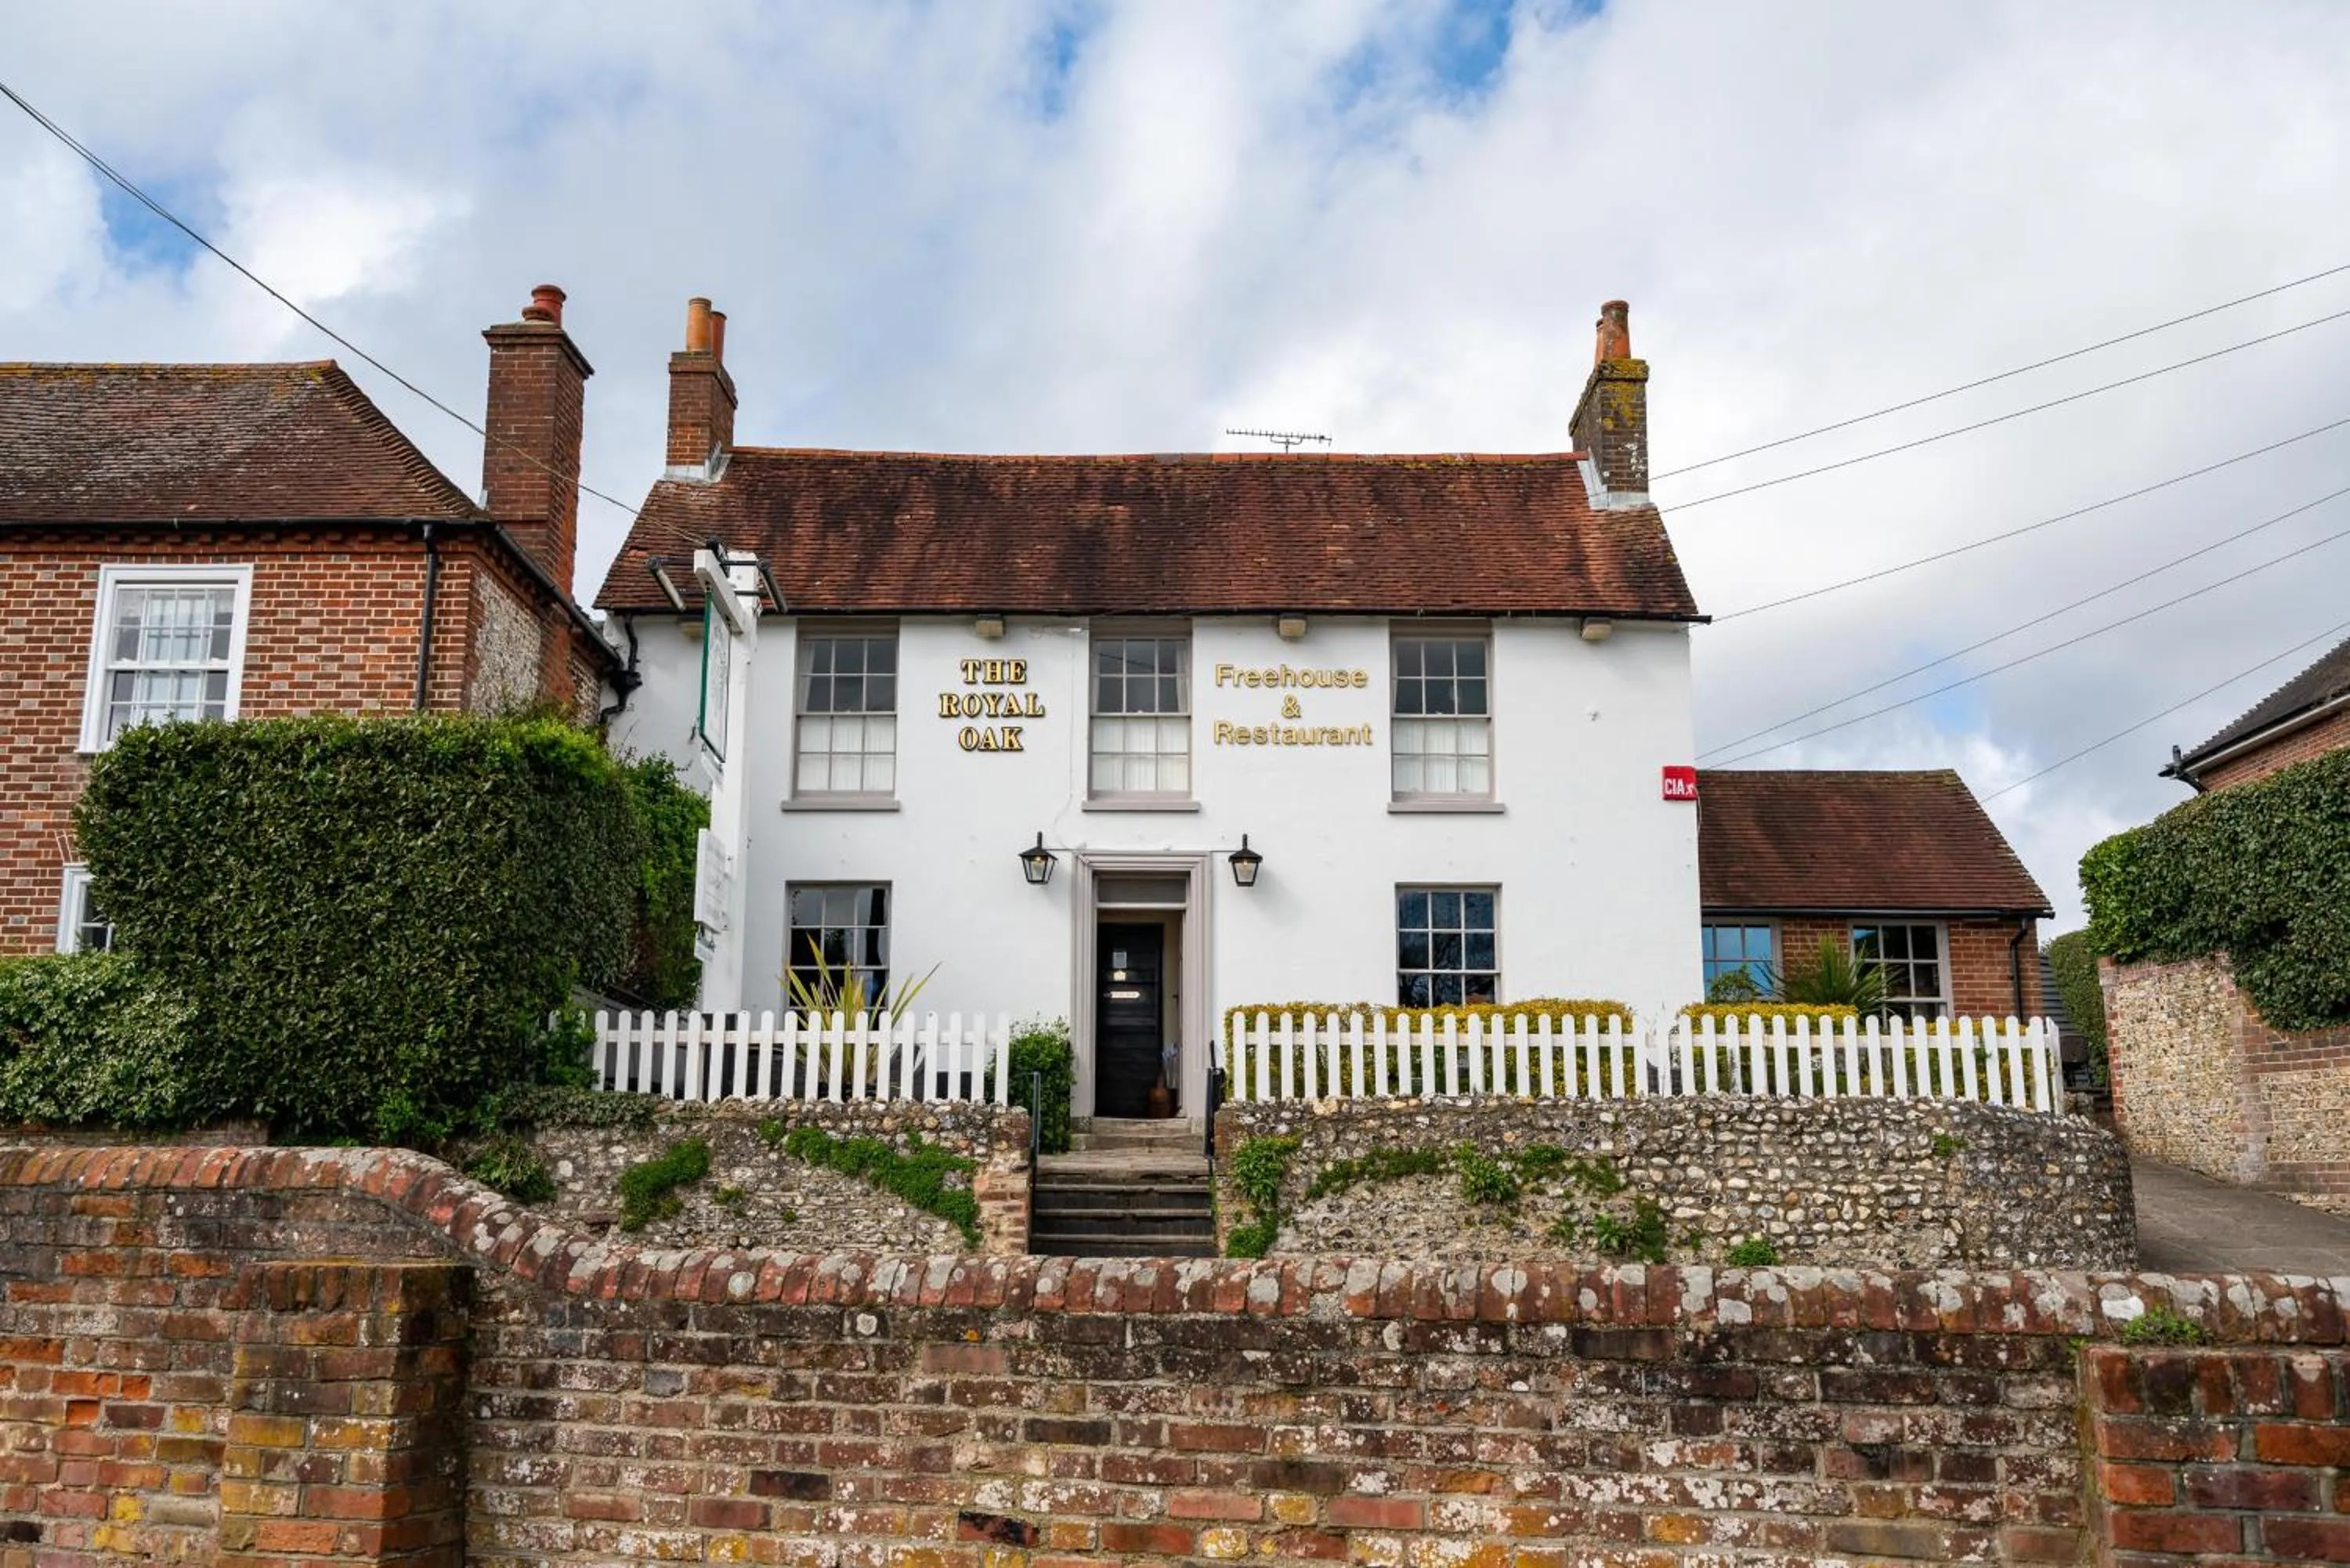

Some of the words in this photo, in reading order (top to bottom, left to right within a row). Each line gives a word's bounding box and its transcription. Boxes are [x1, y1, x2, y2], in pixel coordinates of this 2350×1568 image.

[960, 659, 1027, 685] THE
[1215, 663, 1368, 688] Freehouse
[939, 693, 1045, 718] ROYAL
[1282, 695, 1301, 718] &
[959, 726, 1024, 752] OAK
[1214, 721, 1373, 746] Restaurant
